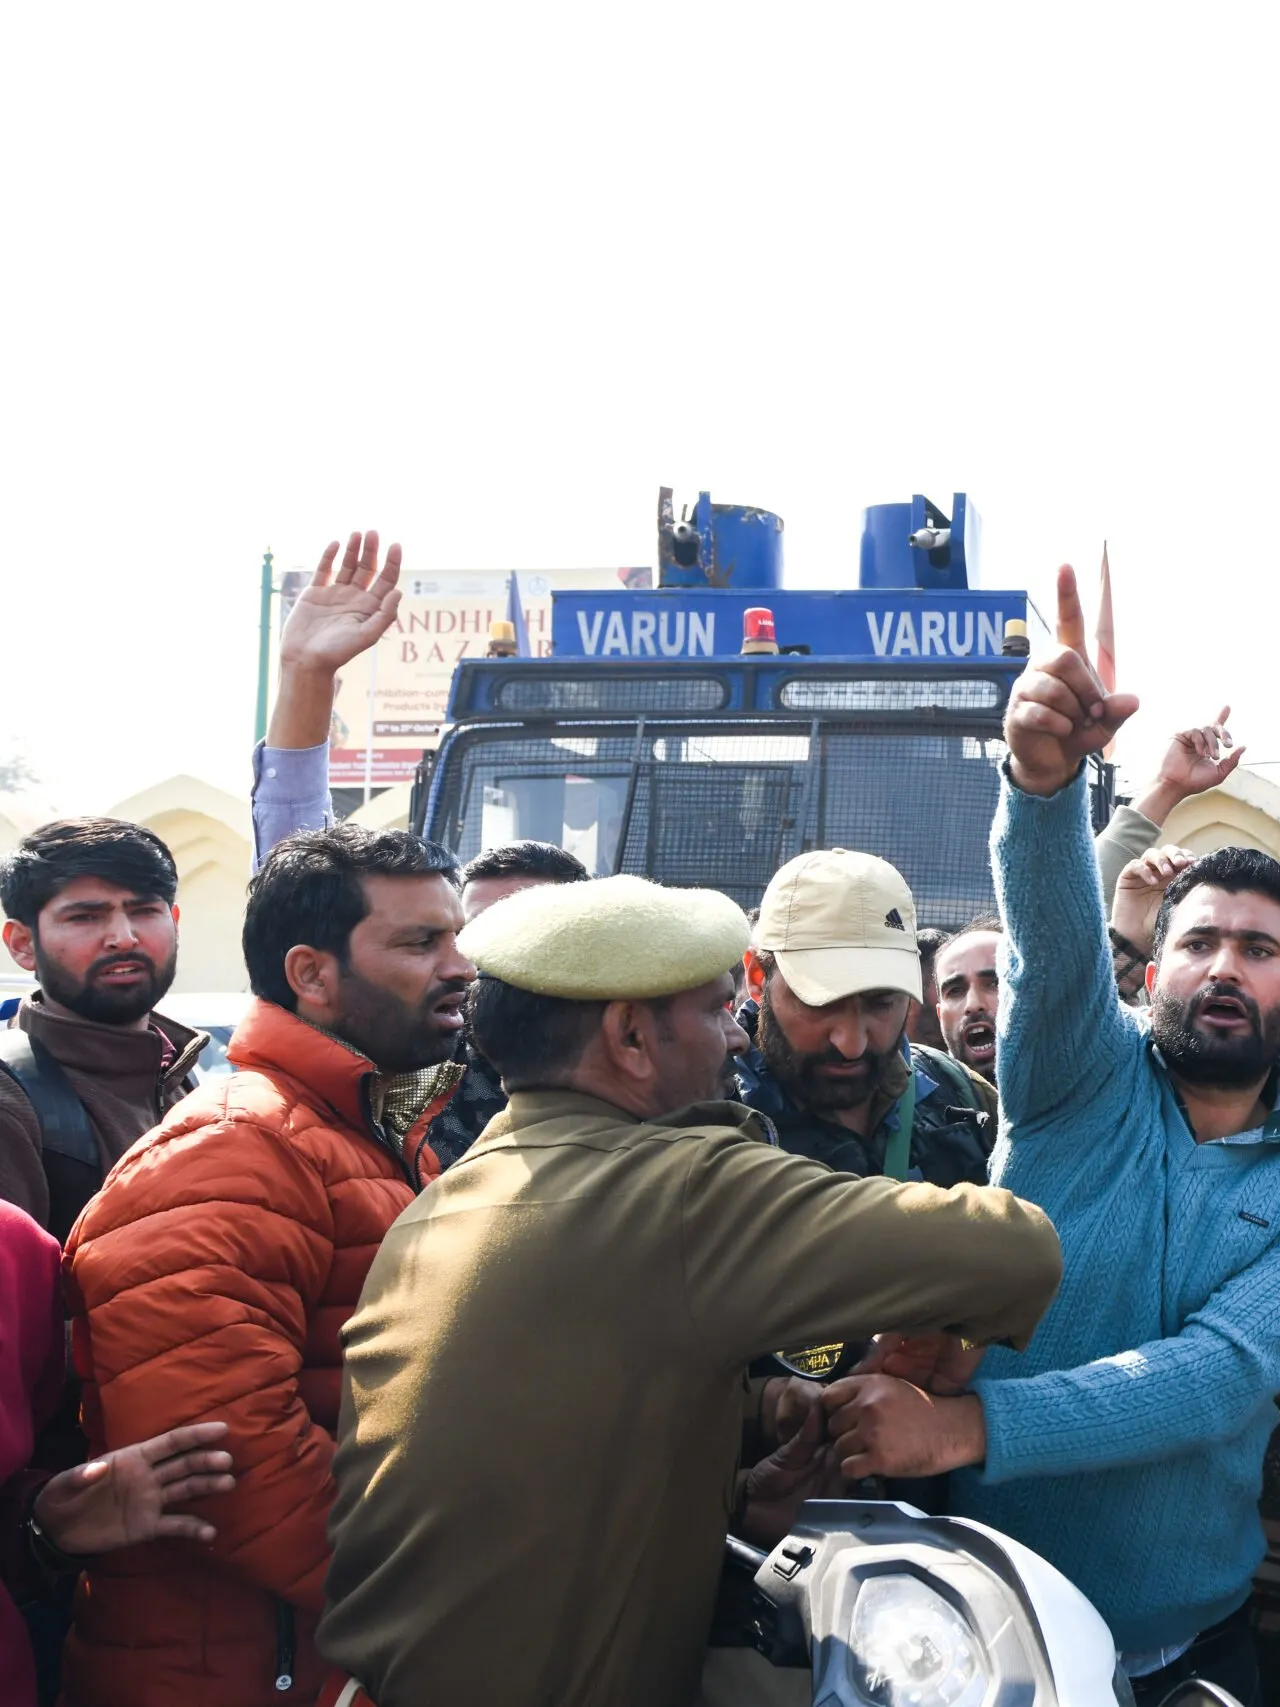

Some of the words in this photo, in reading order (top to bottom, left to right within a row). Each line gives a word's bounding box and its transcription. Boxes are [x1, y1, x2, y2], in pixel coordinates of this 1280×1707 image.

[383, 609, 492, 634] ANDHI
[576, 611, 716, 656] VARUN
[866, 611, 1004, 656] VARUN
[401, 640, 553, 663] BAZR
